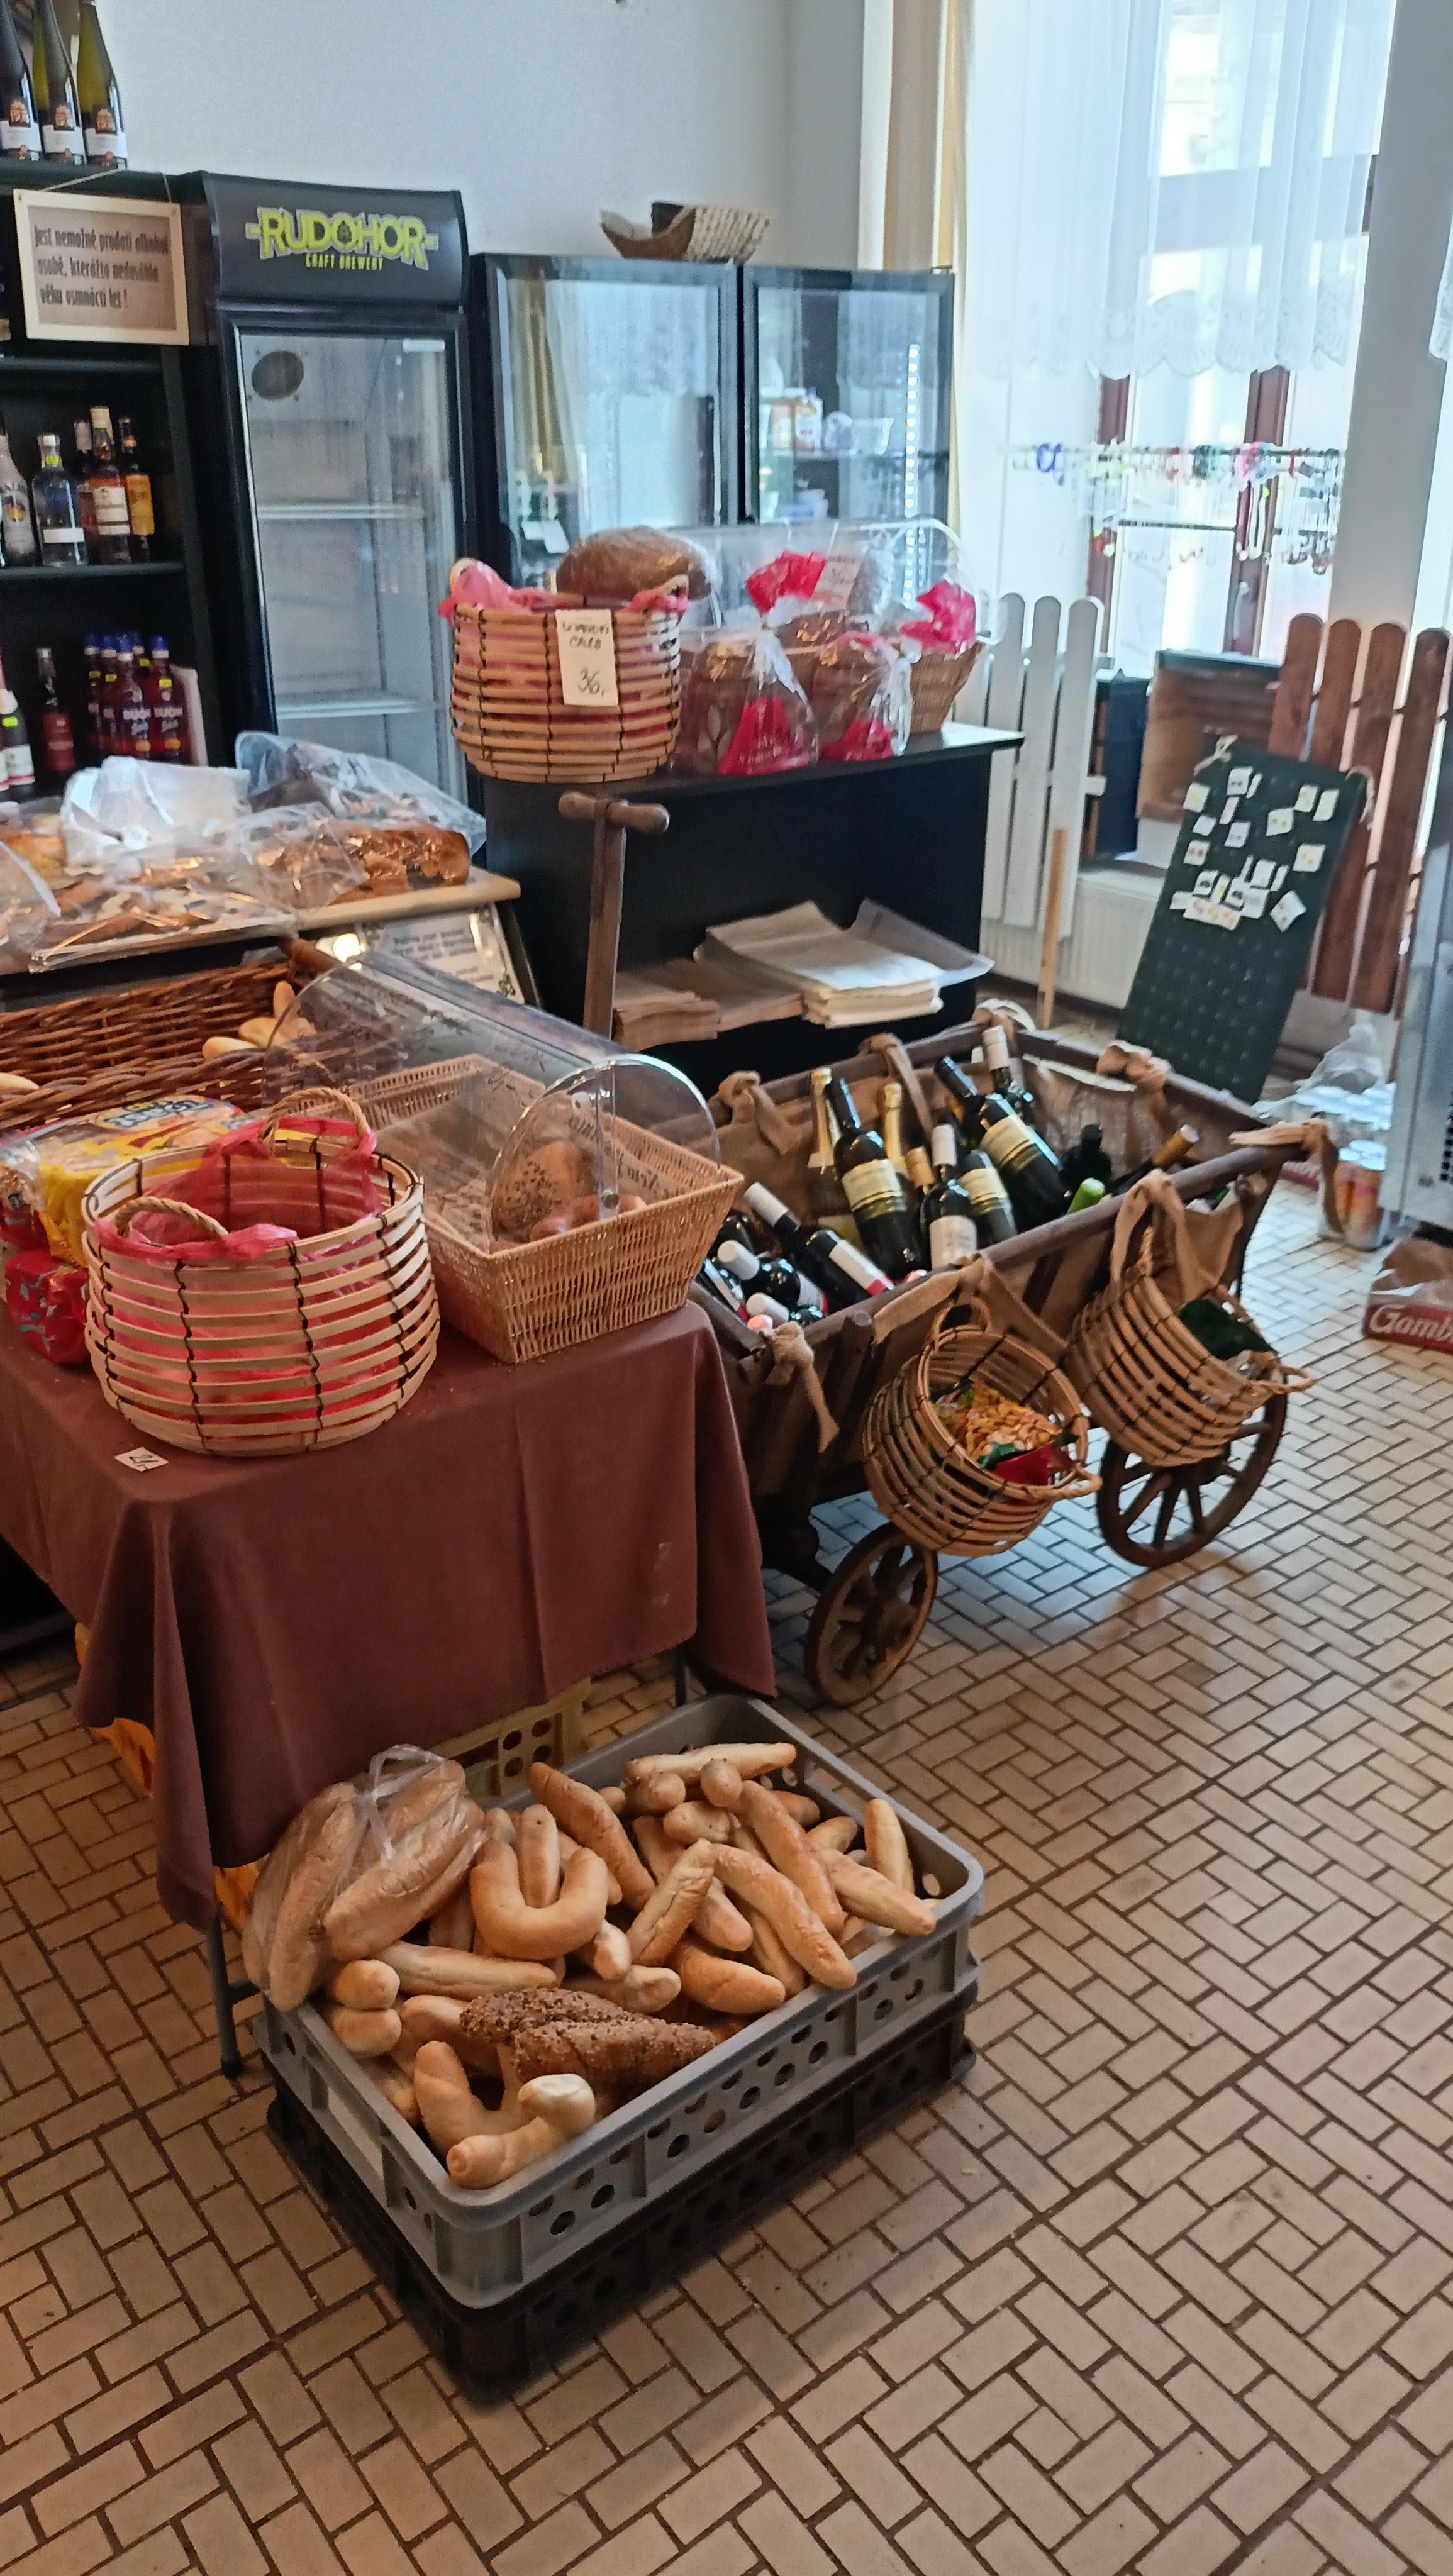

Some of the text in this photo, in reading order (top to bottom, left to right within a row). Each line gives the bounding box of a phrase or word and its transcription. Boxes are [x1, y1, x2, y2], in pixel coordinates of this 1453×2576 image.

[306, 253, 383, 270] CRAFT BREWERY
[1370, 1304, 1453, 1344] Gamb
